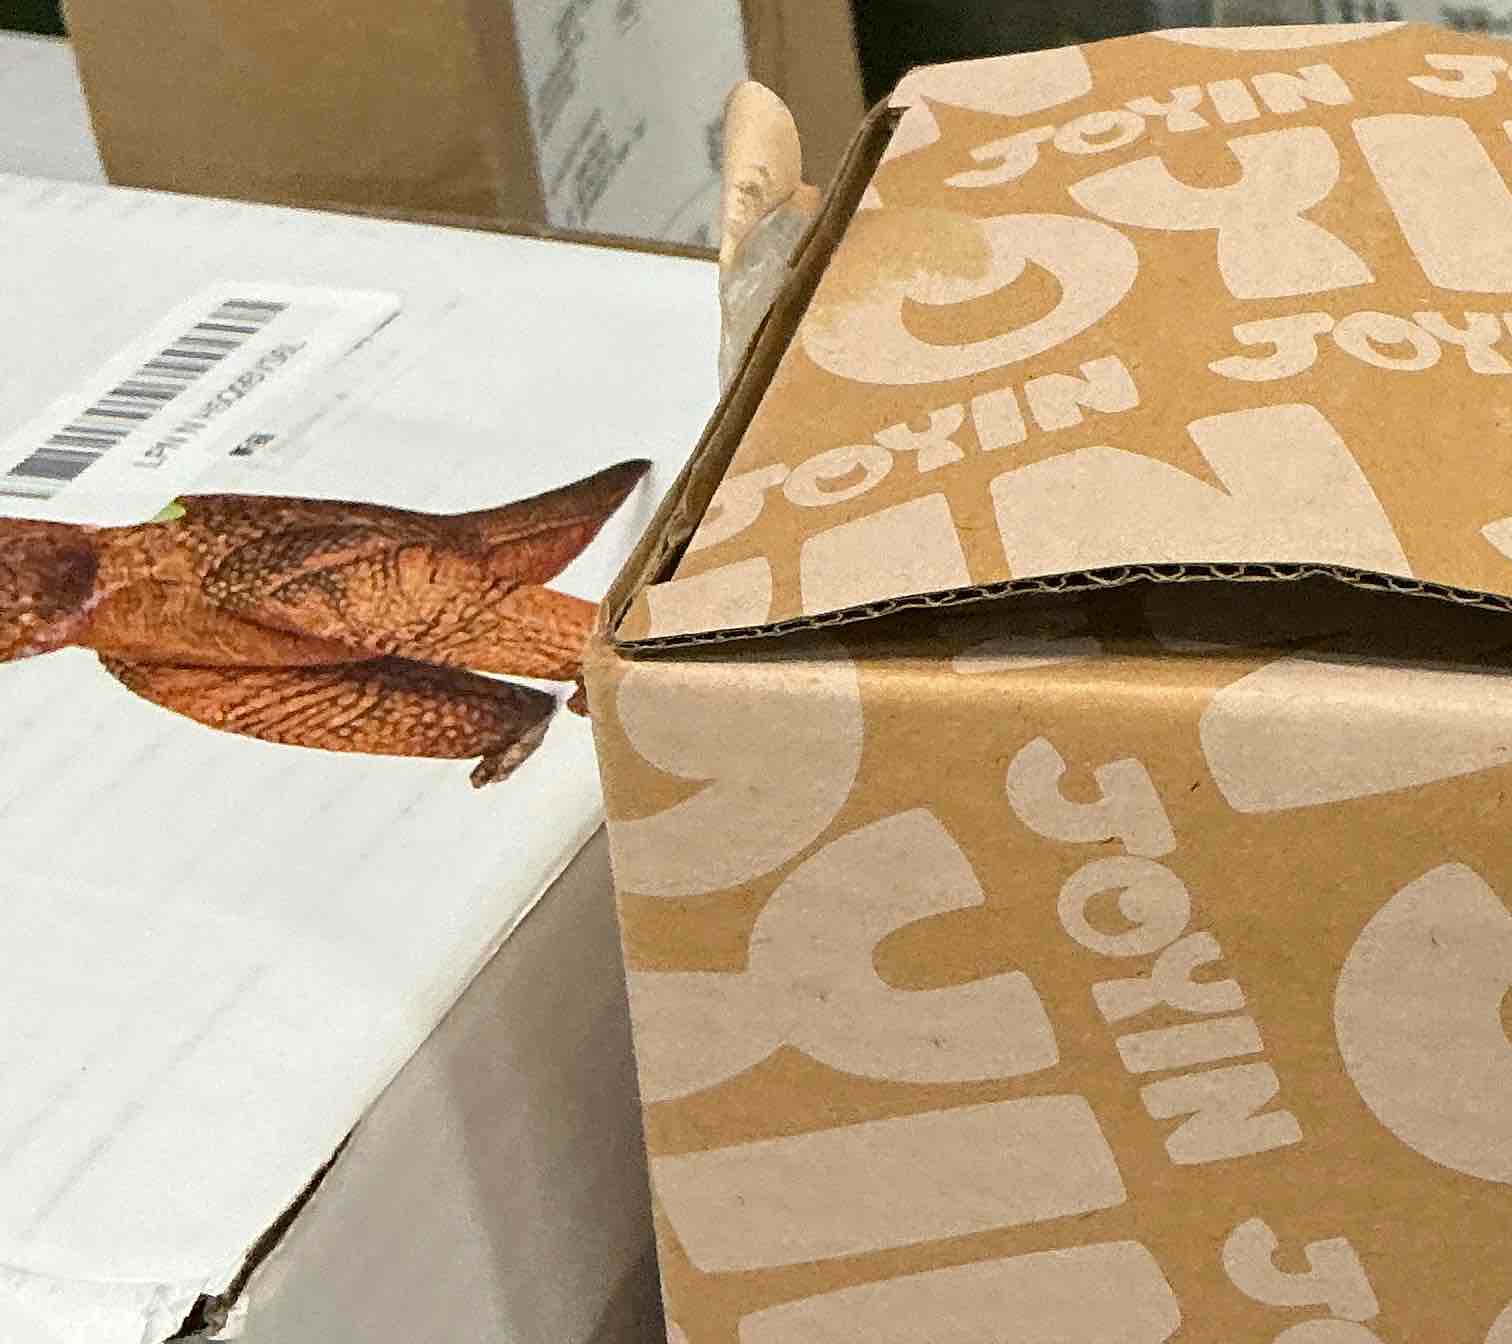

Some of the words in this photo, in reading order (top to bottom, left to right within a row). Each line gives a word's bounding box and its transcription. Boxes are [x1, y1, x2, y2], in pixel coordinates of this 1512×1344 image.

[944, 62, 1359, 190] JOYIN
[693, 356, 1141, 547] JOYIN
[1007, 736, 1304, 1167] JOYIN
